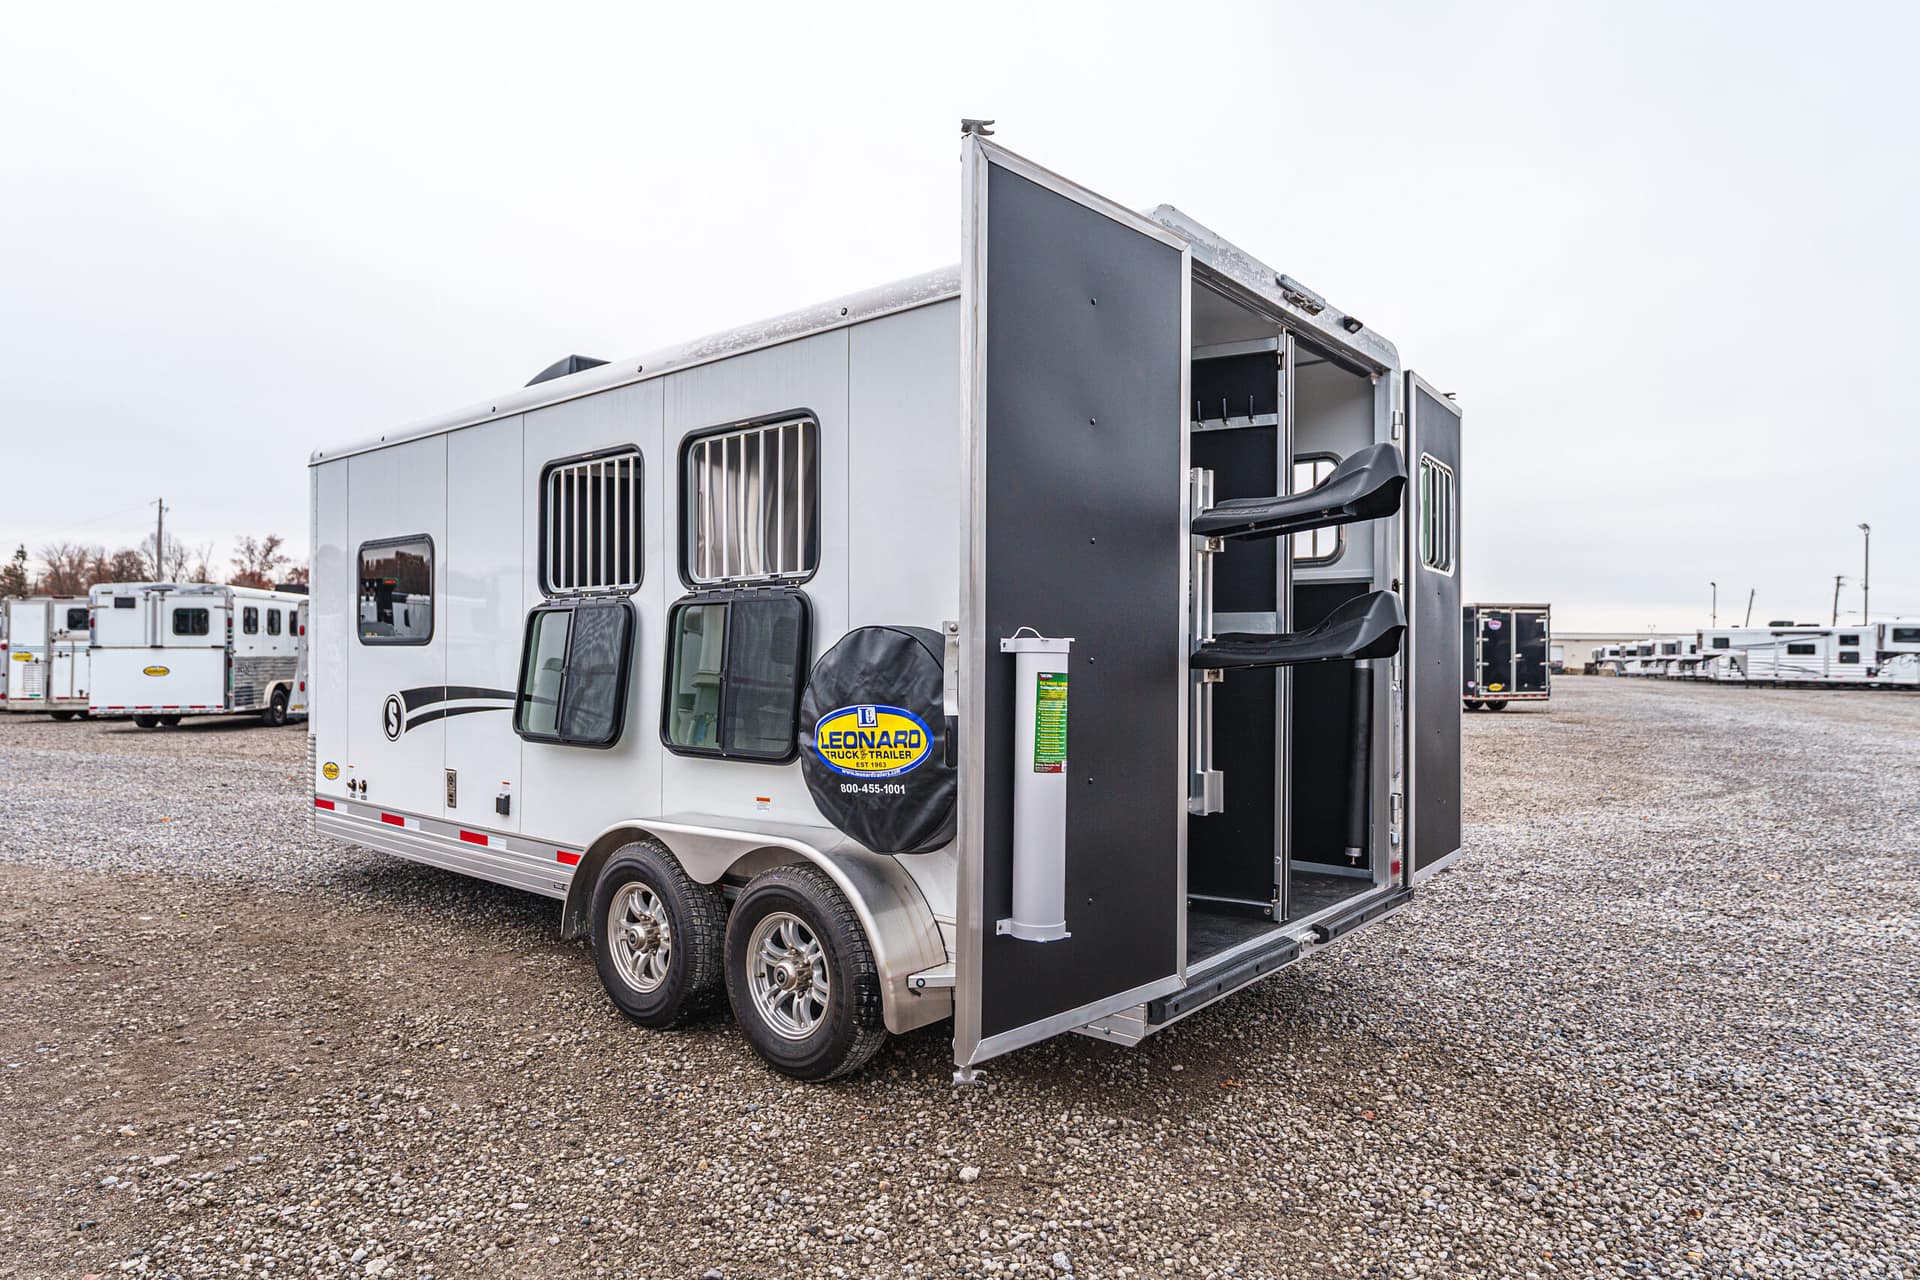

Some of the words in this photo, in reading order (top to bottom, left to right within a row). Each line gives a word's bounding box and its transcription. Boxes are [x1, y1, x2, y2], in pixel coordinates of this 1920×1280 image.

[387, 701, 398, 735] S
[820, 730, 921, 749] LEONARD
[825, 750, 858, 760] TRUCK
[869, 750, 912, 760] TRAILER
[840, 783, 906, 795] 800-455-1001
